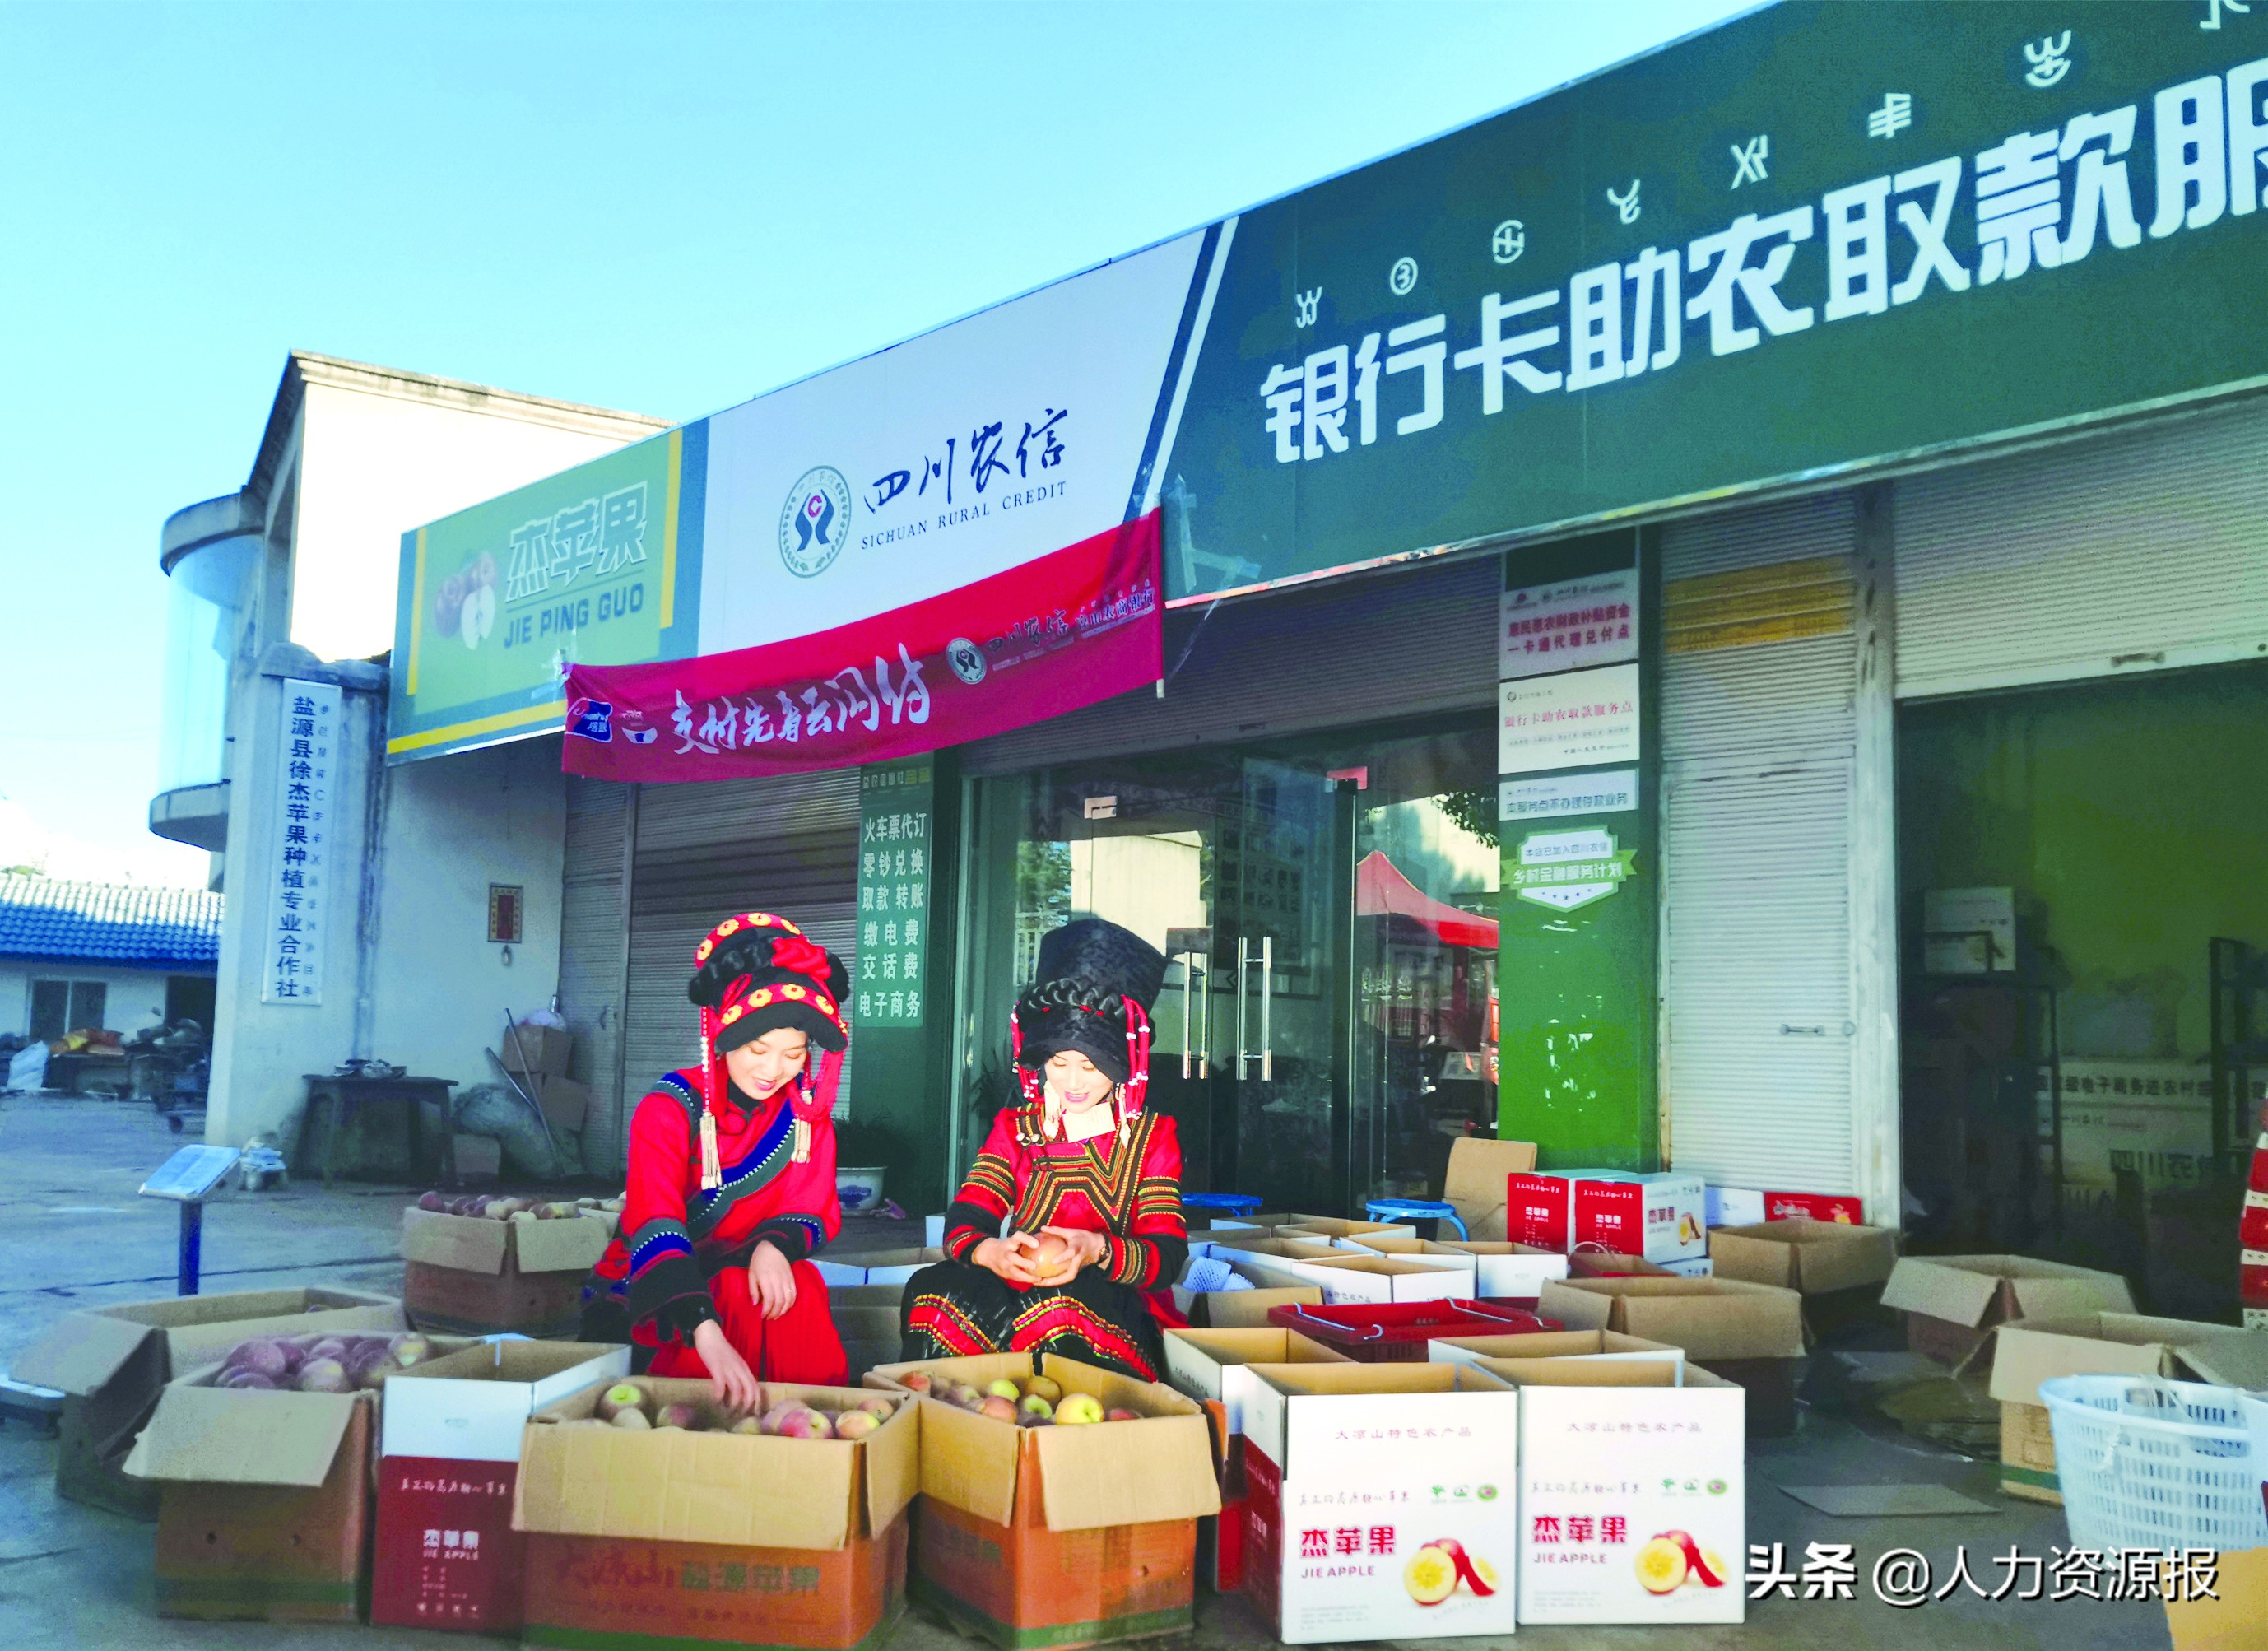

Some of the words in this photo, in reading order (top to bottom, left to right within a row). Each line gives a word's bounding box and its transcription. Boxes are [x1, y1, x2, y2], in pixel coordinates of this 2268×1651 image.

[1260, 57, 2268, 463] 银行卡助农取款服
[863, 407, 1068, 514] 四川农信
[861, 520, 928, 550] SICHUAN
[937, 502, 990, 530] RURAL
[1002, 480, 1067, 510] CREDIT
[504, 480, 648, 603] 杰苹果
[504, 617, 533, 649] JIE
[538, 602, 590, 639] PING
[597, 584, 644, 623] GUO
[864, 812, 927, 844] 火车票代订
[275, 696, 316, 998] 盐源县徐杰苹果种植专业合作社
[863, 847, 923, 879] 零钞兑换
[862, 884, 889, 911] 取款
[895, 882, 924, 910] 转账
[863, 919, 919, 947] 缴电费
[862, 951, 918, 980] 交话费
[859, 989, 921, 1018] 电子商务
[1335, 1426, 1471, 1440] 大凉山特色农产品
[1299, 1524, 1397, 1559] 杰苹果
[1532, 1514, 1627, 1544] 杰苹果
[1301, 1566, 1323, 1579] JIE
[1327, 1565, 1375, 1578] APPLE
[1533, 1553, 1556, 1564] JIE
[1559, 1552, 1607, 1565] APPLE
